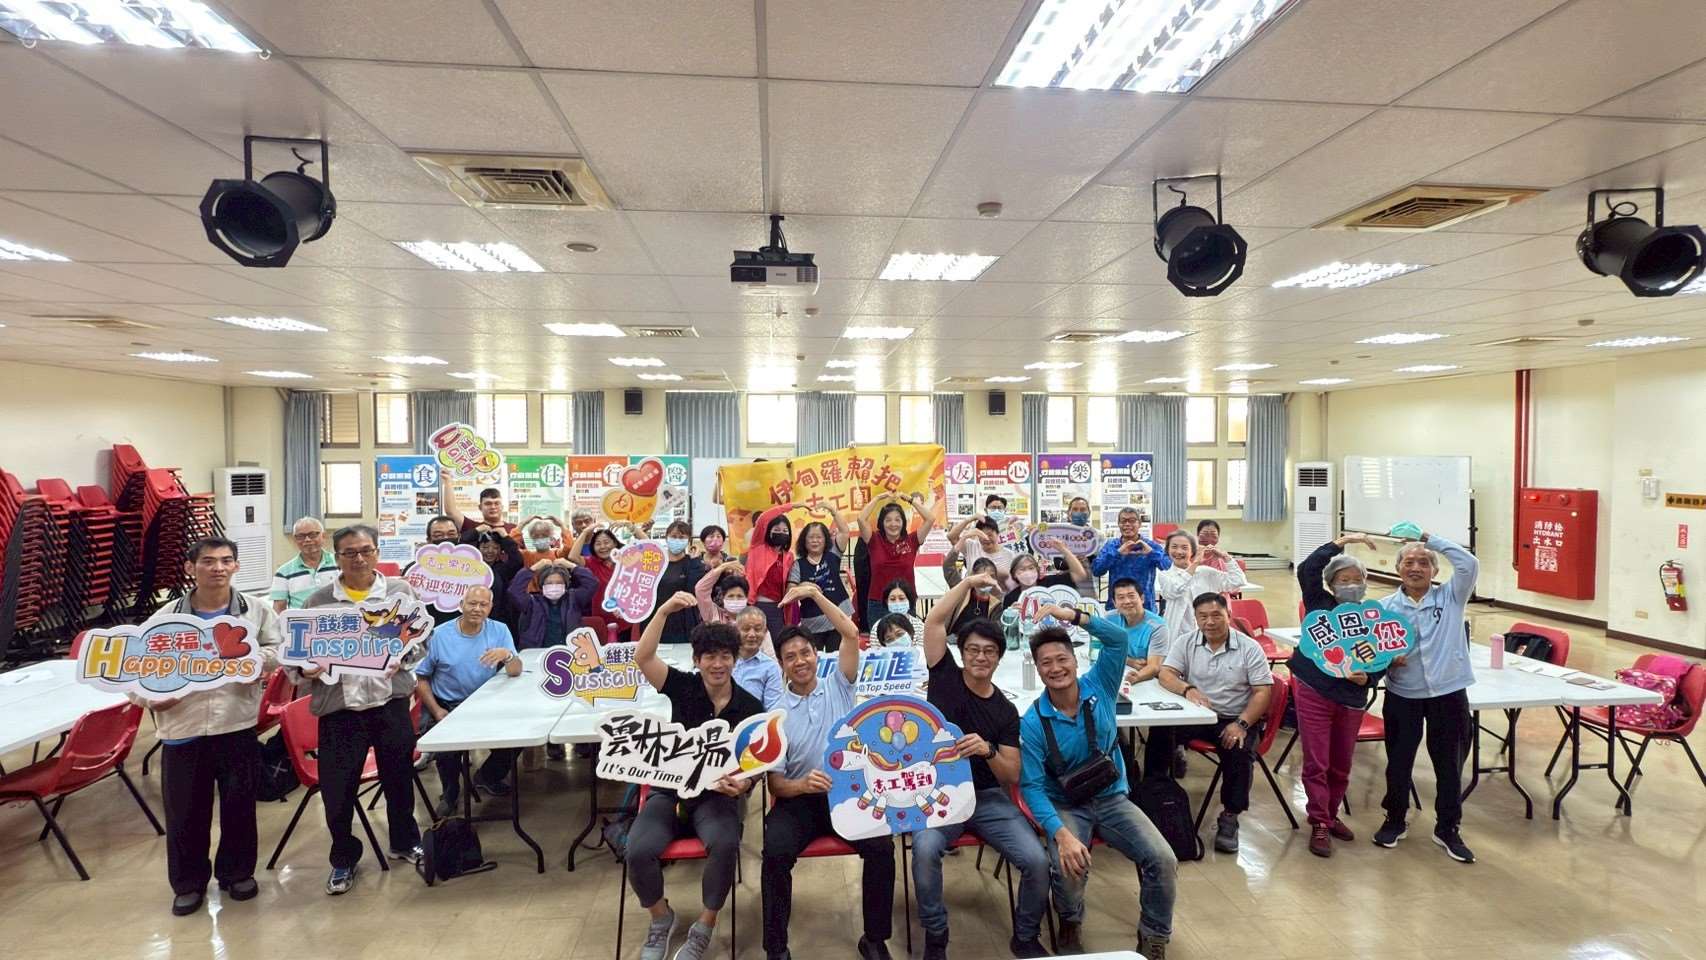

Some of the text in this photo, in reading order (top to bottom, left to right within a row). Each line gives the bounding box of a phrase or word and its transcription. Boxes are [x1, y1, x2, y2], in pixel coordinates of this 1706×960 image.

[417, 466, 433, 483] 食
[545, 465, 561, 483] 住
[956, 463, 970, 480] 友
[1010, 465, 1027, 478] 心
[1072, 464, 1089, 480] 樂
[1134, 462, 1150, 480] 學
[1532, 536, 1563, 547] 出水口
[316, 613, 362, 634] 鼓舞
[148, 632, 203, 654] 幸福
[285, 621, 403, 660] Inspire
[83, 635, 256, 678] Happiness
[883, 681, 912, 692] Speed
[599, 715, 732, 791] 雲林上場
[602, 762, 684, 784] It's Our Time
[873, 771, 933, 795] 志工駕到
